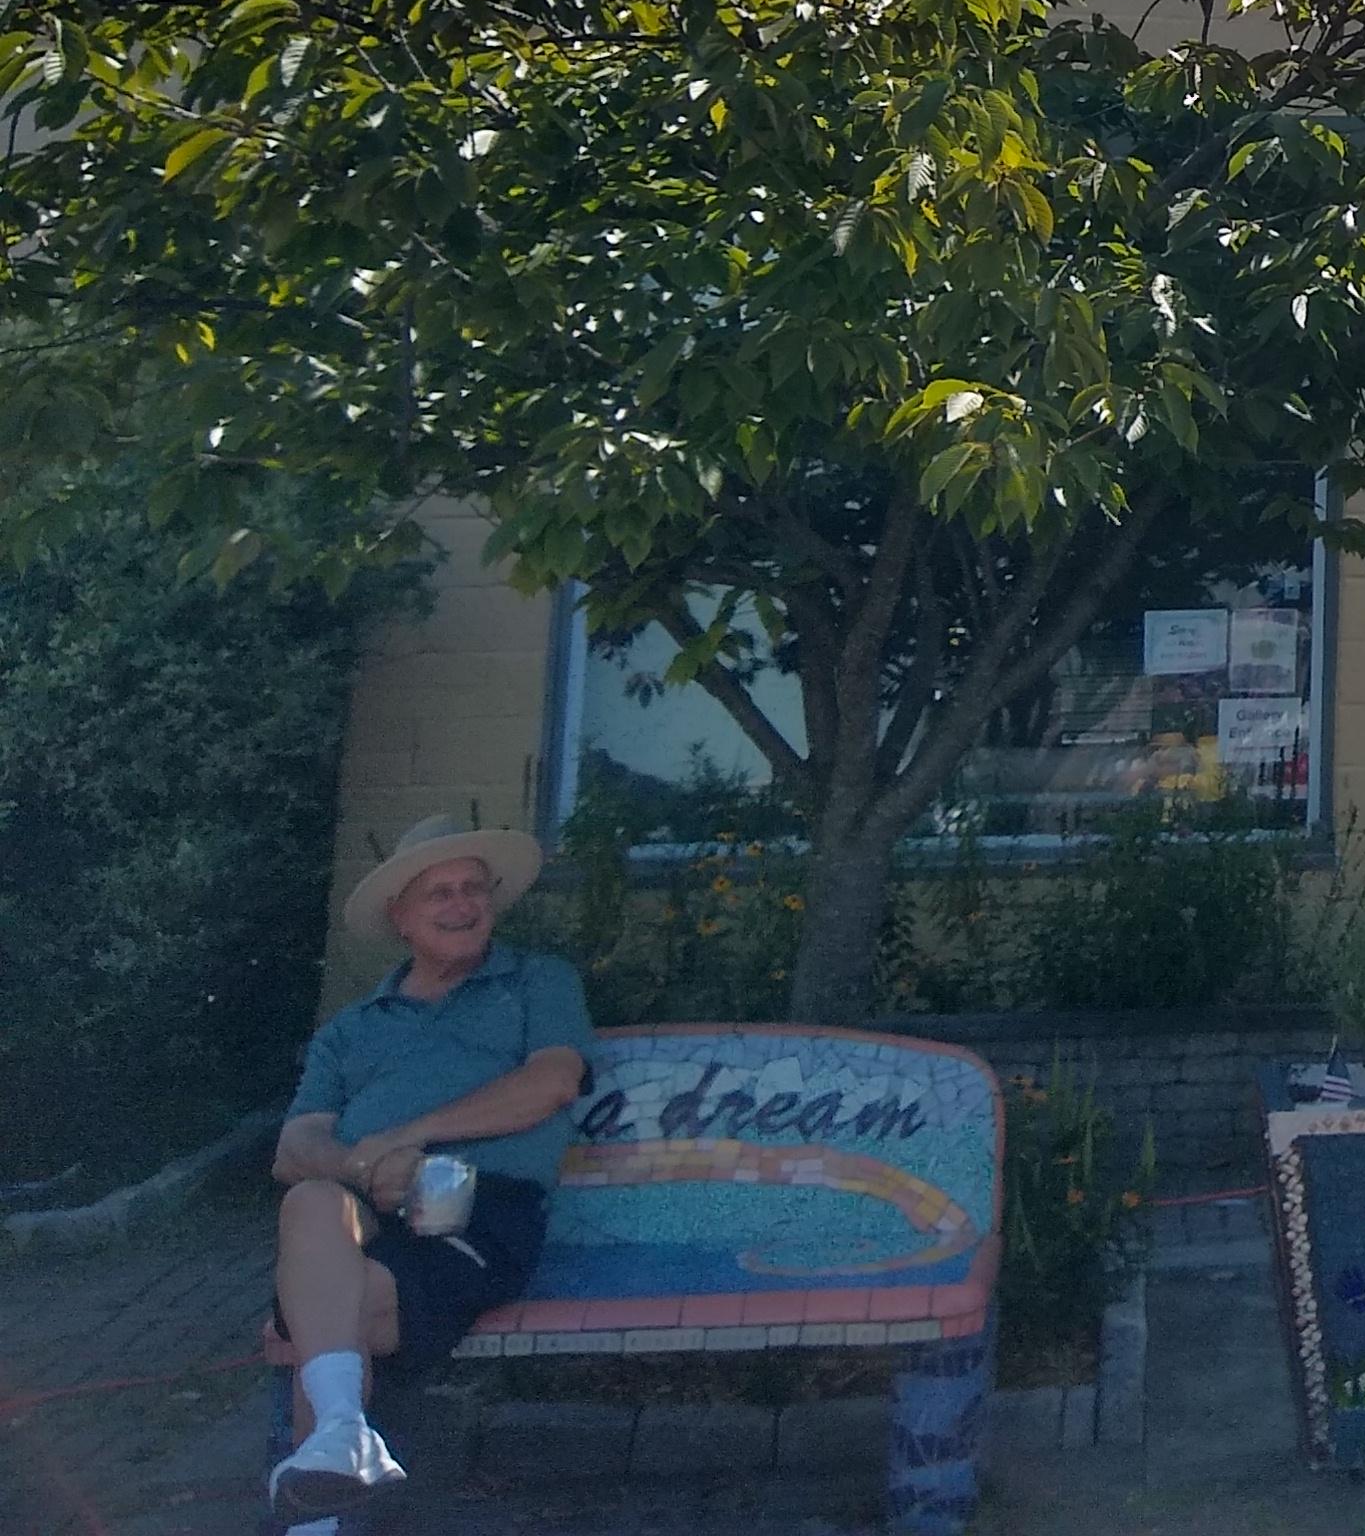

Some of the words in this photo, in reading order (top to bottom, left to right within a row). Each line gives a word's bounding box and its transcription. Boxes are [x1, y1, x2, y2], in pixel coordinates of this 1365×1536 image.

[1235, 708, 1284, 723] Gallery
[1228, 725, 1291, 739] Entce
[578, 1089, 635, 1139] a
[658, 1063, 927, 1141] dream
